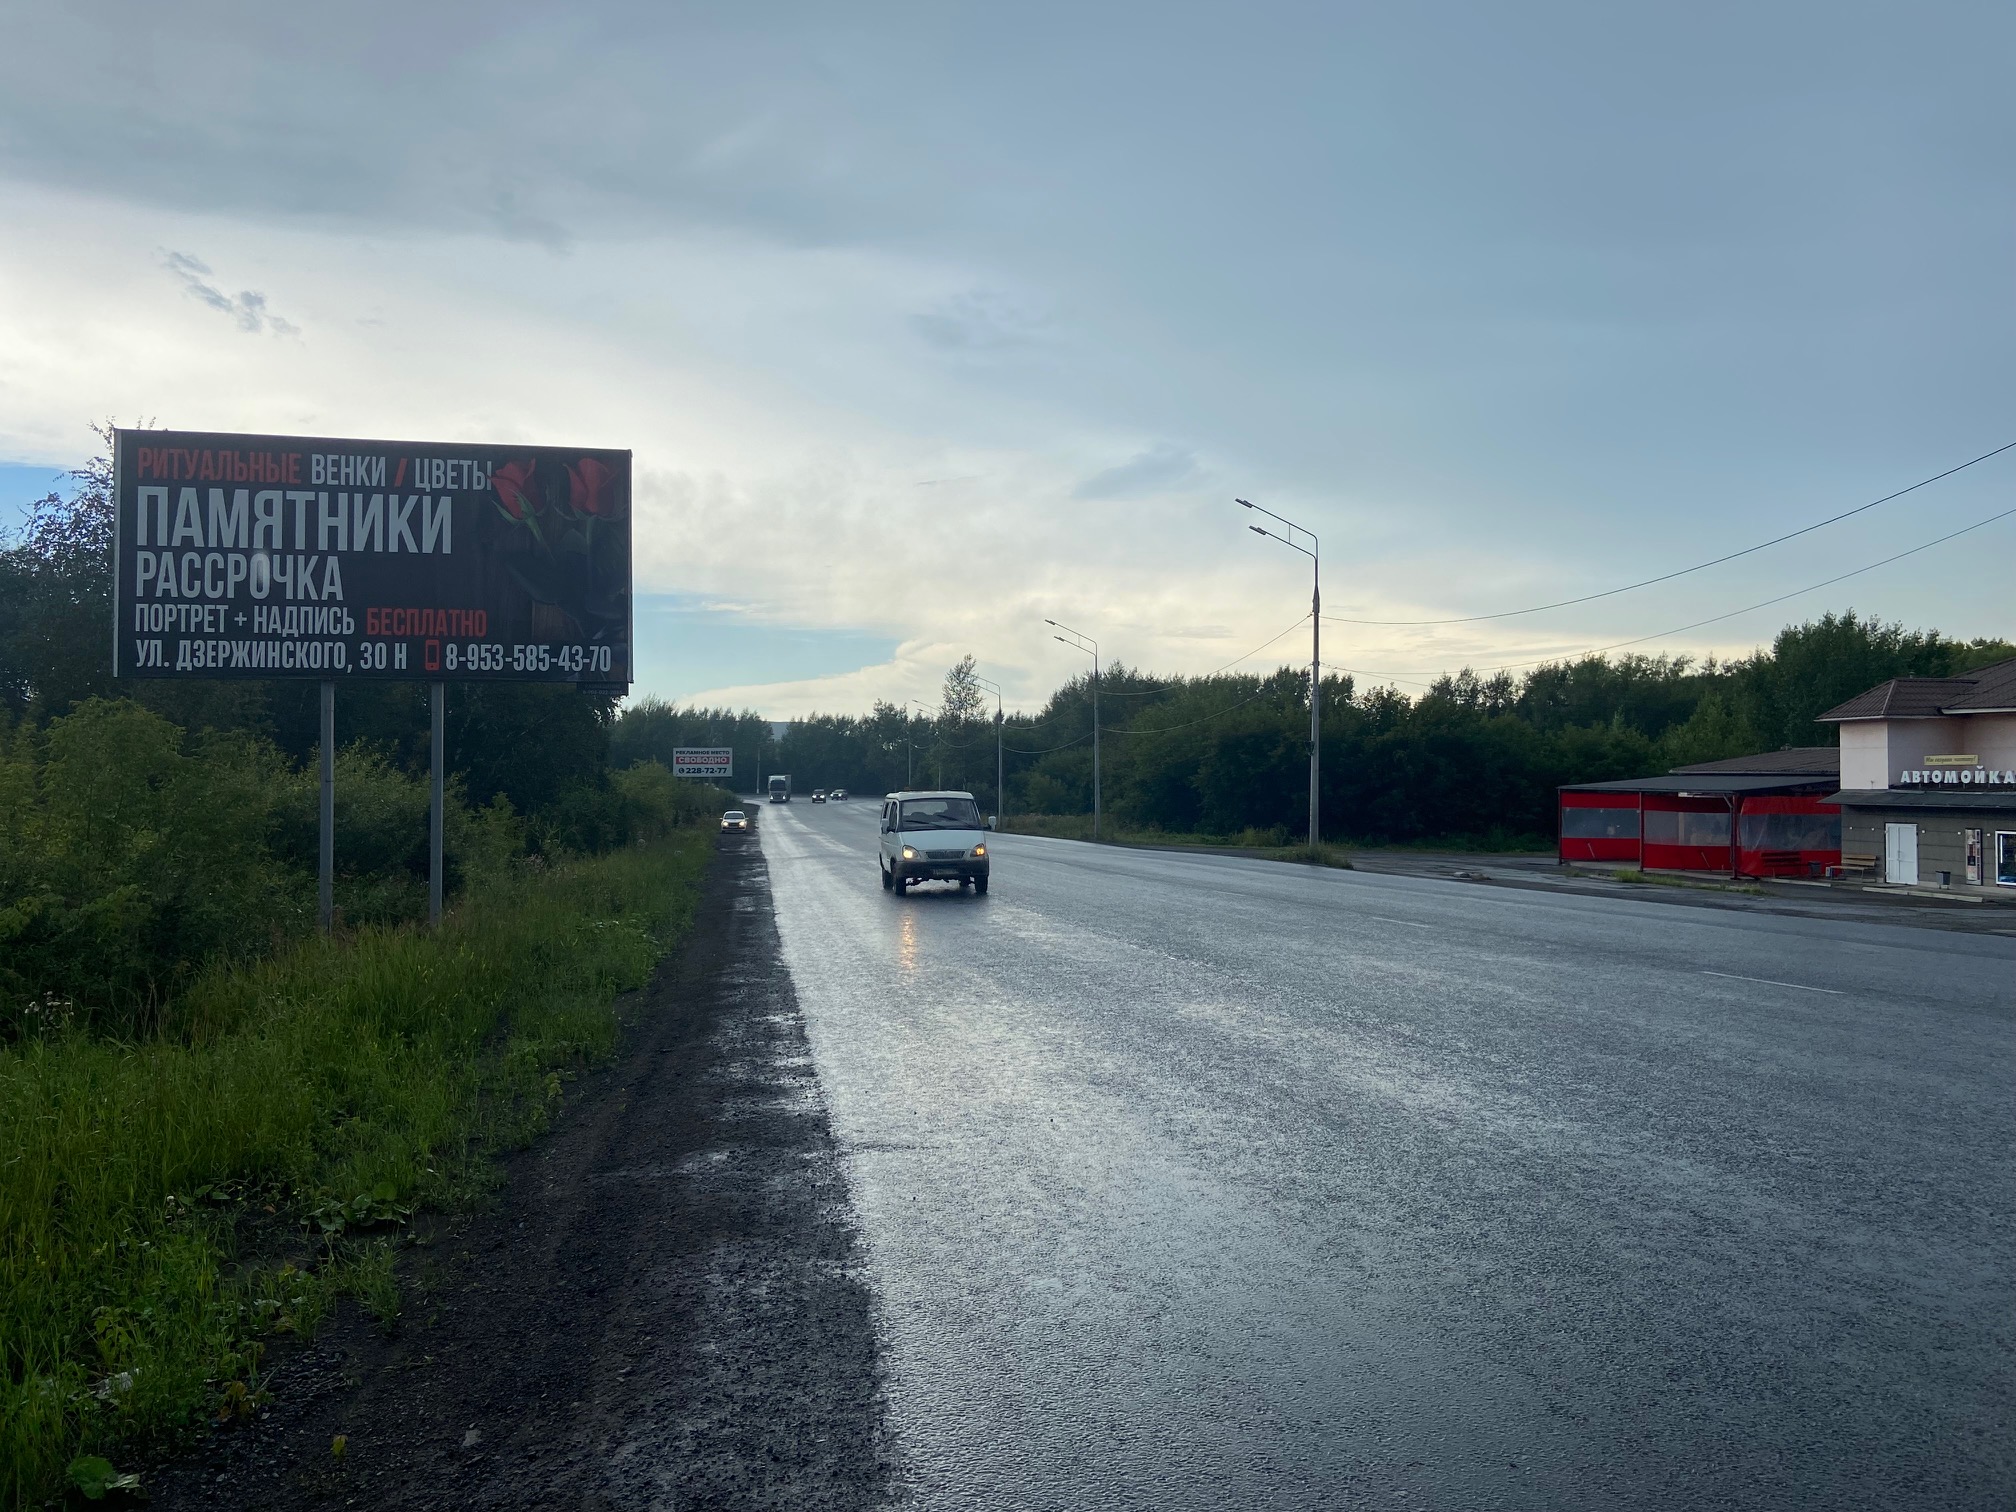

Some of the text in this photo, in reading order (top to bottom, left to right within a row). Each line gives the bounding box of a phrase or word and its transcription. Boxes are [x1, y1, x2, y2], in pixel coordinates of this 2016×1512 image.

[137, 448, 302, 484] РИТУАЛЬНЫЕ
[311, 454, 386, 487] ВЕНКИ
[415, 457, 492, 492] ЦВЕТЫ
[137, 486, 452, 554] ПАМЯТНИКИ
[136, 551, 344, 600] РАССРОЧКА
[135, 603, 487, 638] ПОРТРЕТ + НАДПИСЬ БЕСПЛАТНО
[136, 639, 612, 674] УЛ. ДЗЕРЖИНСКОГО, 30 Н 8-953-585-43-70
[1901, 766, 2016, 783] АВТОМОЙКА
